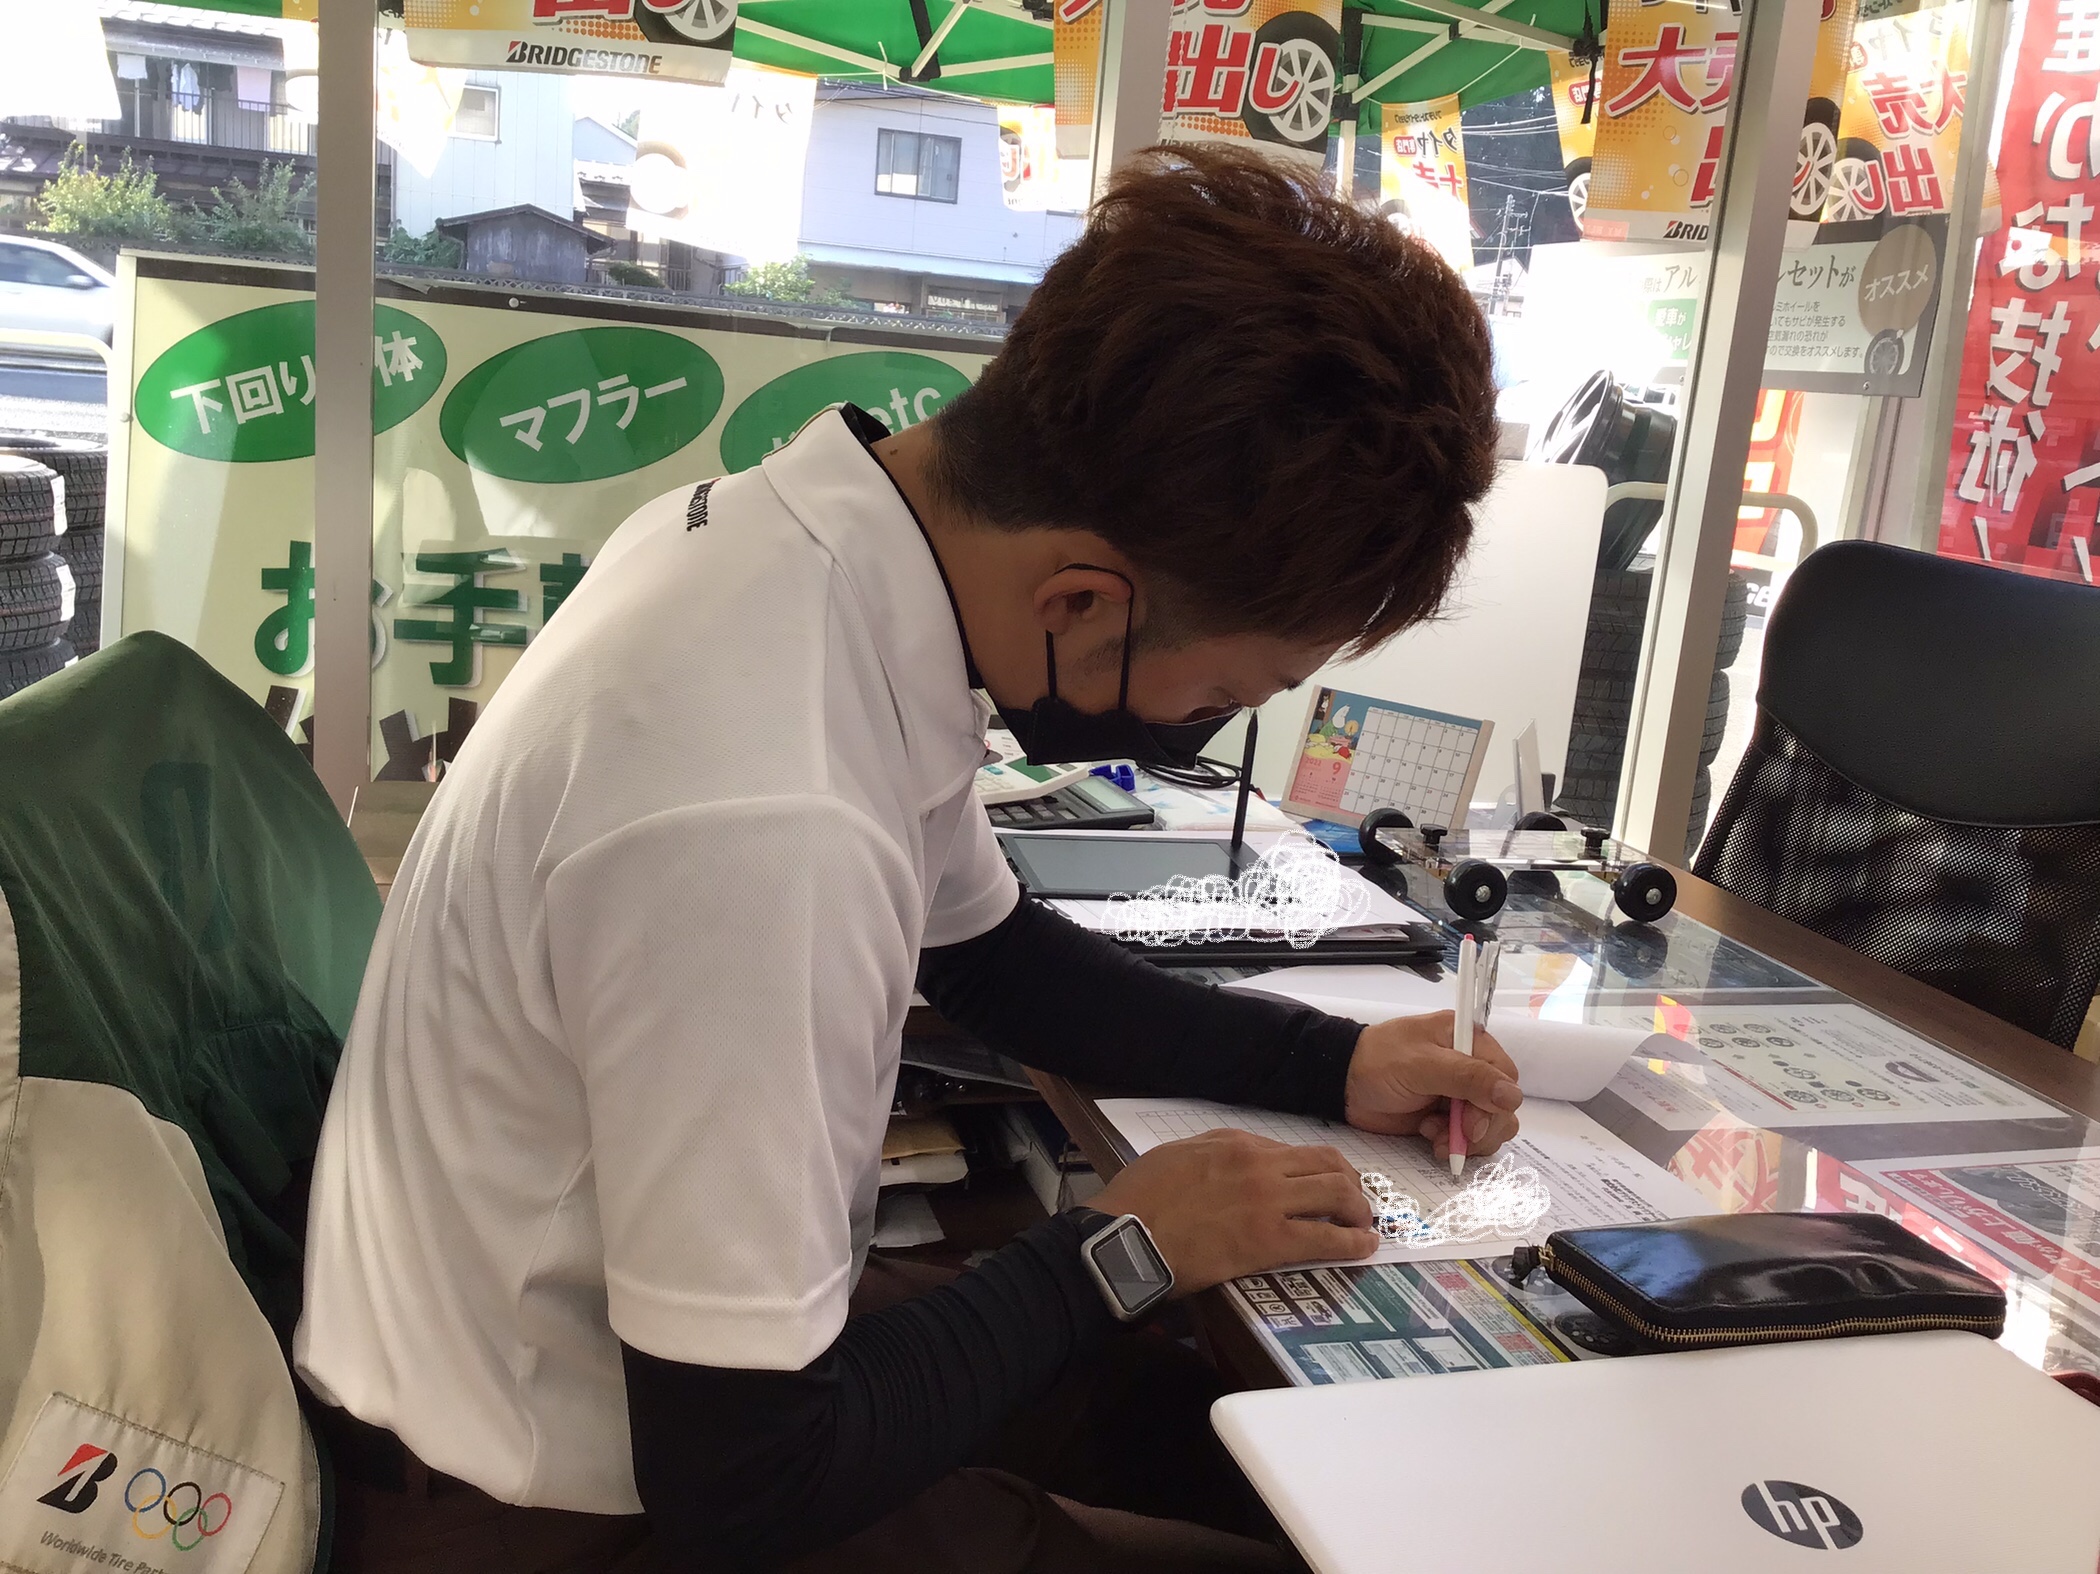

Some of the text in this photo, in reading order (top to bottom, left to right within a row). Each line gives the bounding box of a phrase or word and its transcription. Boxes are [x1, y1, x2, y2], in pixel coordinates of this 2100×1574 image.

[506, 40, 663, 75] BRIDGESTONE
[1163, 23, 1301, 114] 出し
[1778, 255, 1857, 290] セットが
[1864, 264, 1929, 301] オススメ
[500, 373, 687, 452] マフラー
[1333, 762, 1341, 774] 9
[1754, 1480, 1841, 1550] hp
[40, 1530, 107, 1563] Worldwide
[109, 1552, 134, 1572] Tire
